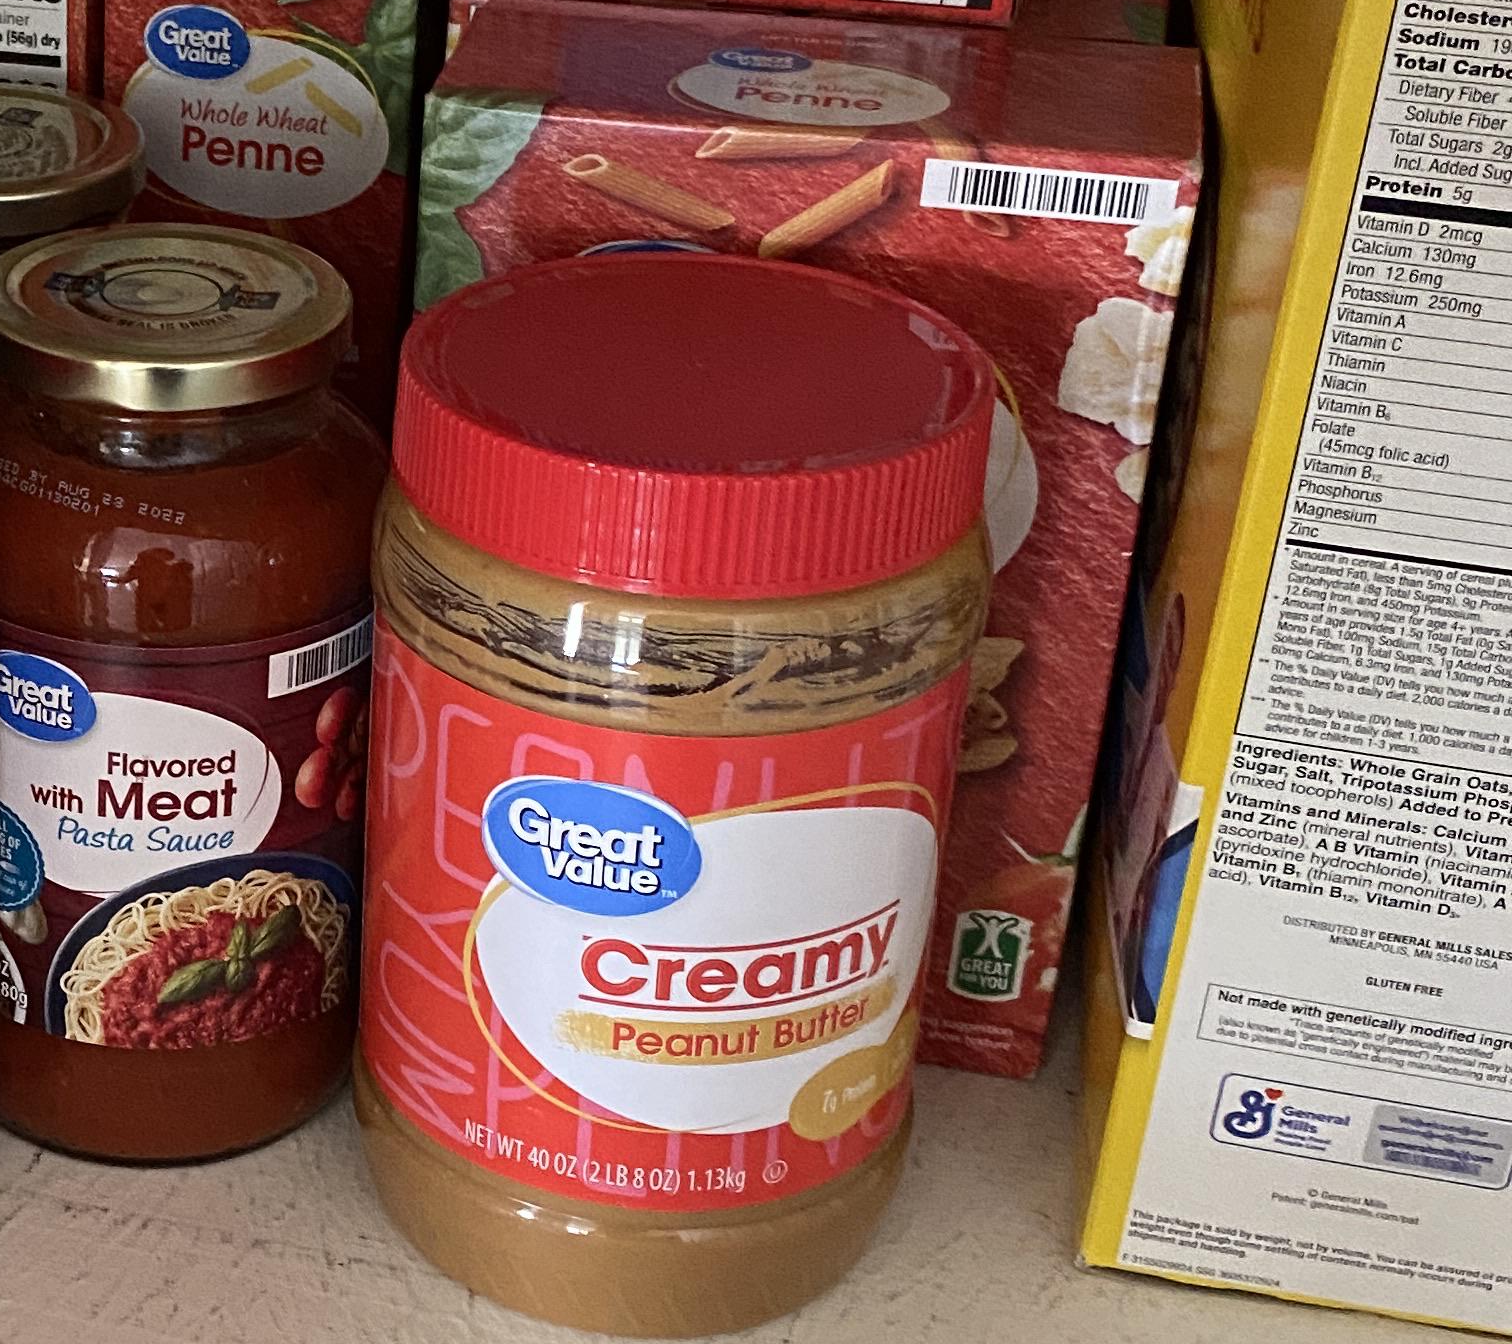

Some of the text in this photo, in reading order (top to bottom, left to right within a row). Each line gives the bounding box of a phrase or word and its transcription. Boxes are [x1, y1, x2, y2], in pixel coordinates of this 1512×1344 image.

[6, 31, 38, 48] (56g)
[41, 34, 61, 50] dry
[159, 20, 232, 51] Great
[1397, 29, 1480, 52] Sodium
[175, 45, 231, 65] Value
[1394, 53, 1446, 75] Total
[735, 86, 883, 111] Penne
[1399, 79, 1499, 106] Dietary Fiber
[180, 98, 328, 136] Whole Wheat
[1405, 105, 1508, 132] Soluble Fiber
[182, 125, 325, 177] Penne
[1388, 128, 1483, 154] Total Sugars
[1365, 175, 1473, 205] Protein 5g
[1357, 214, 1483, 245] Vitamin D 2mcg
[1351, 237, 1477, 269] Calcium 130mg
[1345, 260, 1443, 289] Iron 12.6mg
[1341, 284, 1482, 317] Potassium 250mg
[1337, 306, 1392, 328] Vitamin
[1331, 329, 1388, 351] Vitamin
[1326, 352, 1385, 373] Thiamin
[1321, 374, 1367, 394] Niacin
[1311, 418, 1356, 437] Folate
[58, 480, 90, 500] AUG
[137, 502, 186, 525] 2022
[1298, 479, 1383, 505] Phosphorus
[1294, 500, 1377, 525] Magnesium
[1287, 521, 1319, 539] Zinc
[8, 696, 74, 730] Value
[107, 750, 237, 779] Flavored
[1236, 740, 1461, 788] Ingredients: Whole Grain
[30, 776, 238, 822] with Meat
[1341, 773, 1457, 802] Tripotassium
[1226, 791, 1428, 835] Vitamins Minerals:
[58, 814, 235, 853] Pasta Sauce
[508, 798, 664, 868] Great
[540, 847, 663, 897] Value
[580, 911, 899, 1005] Creamy
[960, 958, 1013, 976] GREAT
[980, 973, 1009, 990] YOU
[1366, 976, 1444, 998] GLUTEN FREE
[612, 1022, 760, 1058] Peanut
[773, 997, 869, 1050] Butter
[1218, 990, 1476, 1044] Not made with genetically modified
[1281, 1105, 1351, 1128] General
[465, 1118, 746, 1195] NET WT 40 OZ LB 8 OZ) 1.13kg
